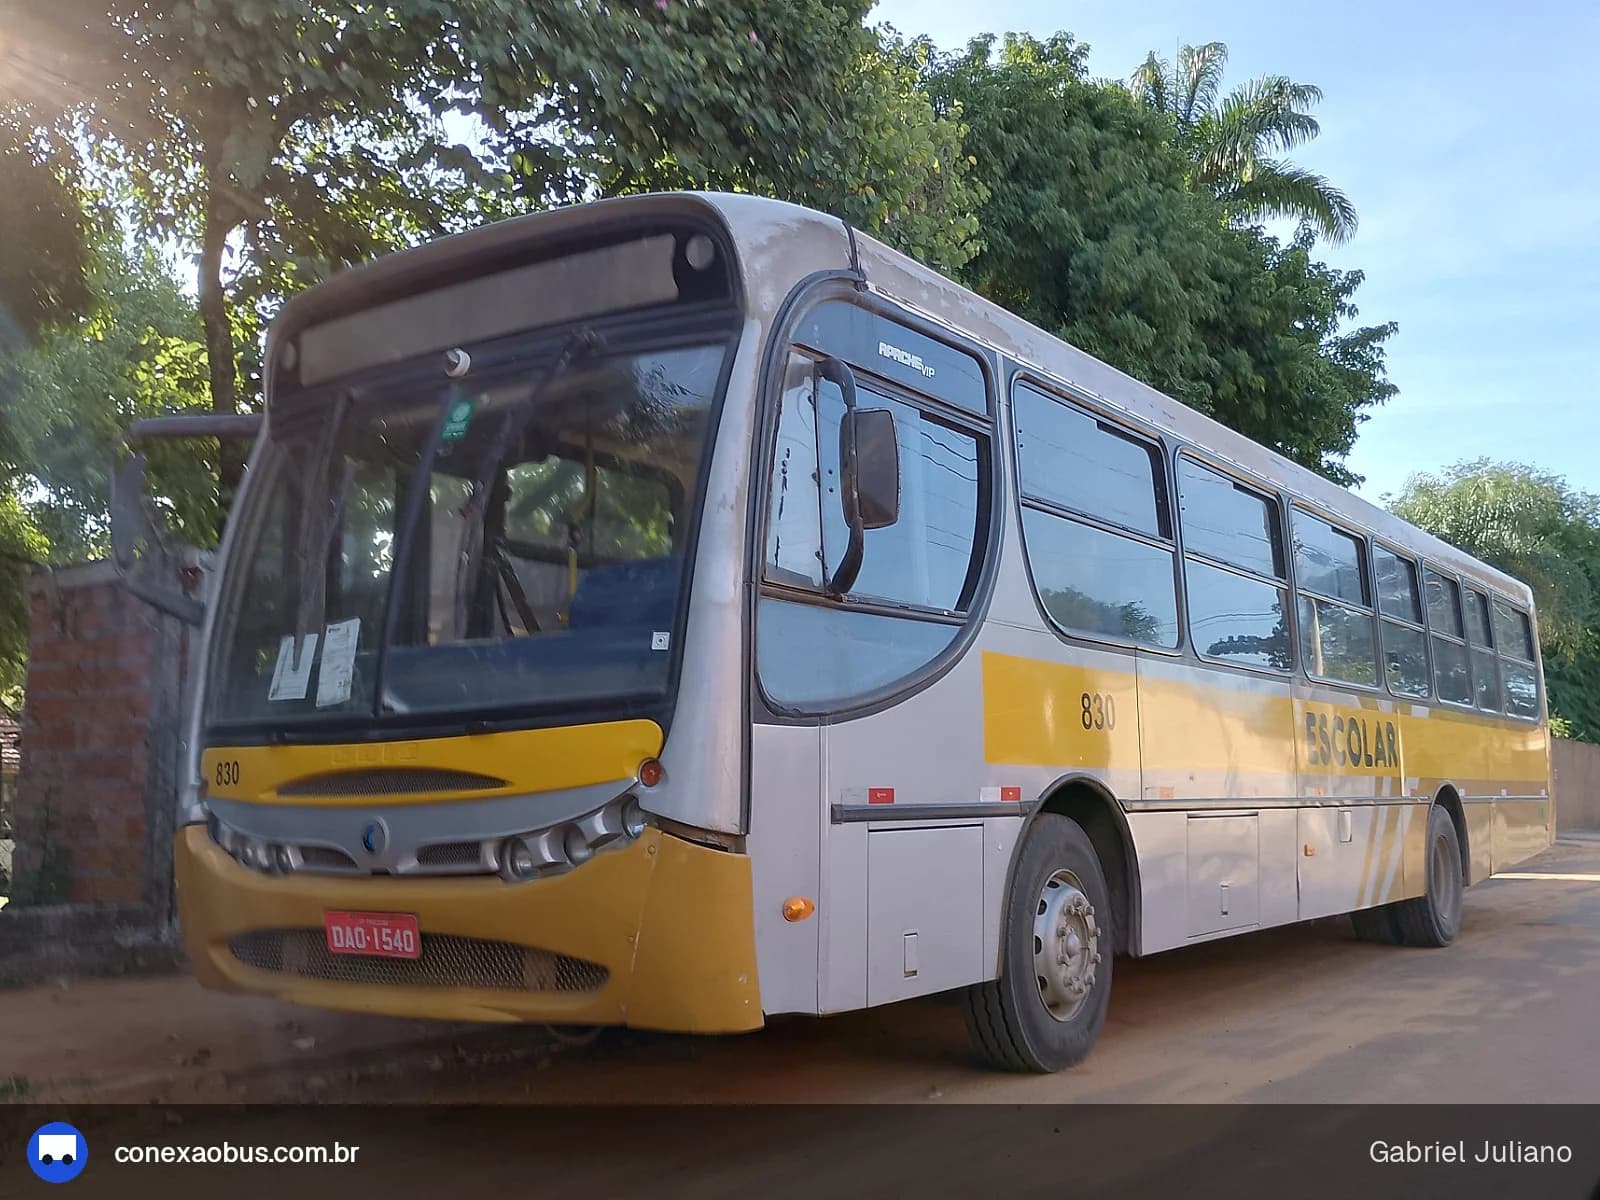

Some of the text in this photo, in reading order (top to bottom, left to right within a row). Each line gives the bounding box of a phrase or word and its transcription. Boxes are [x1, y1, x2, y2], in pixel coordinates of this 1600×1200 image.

[1081, 693, 1115, 730] 830
[1306, 711, 1398, 768] ESCOLAR
[216, 761, 239, 786] 830
